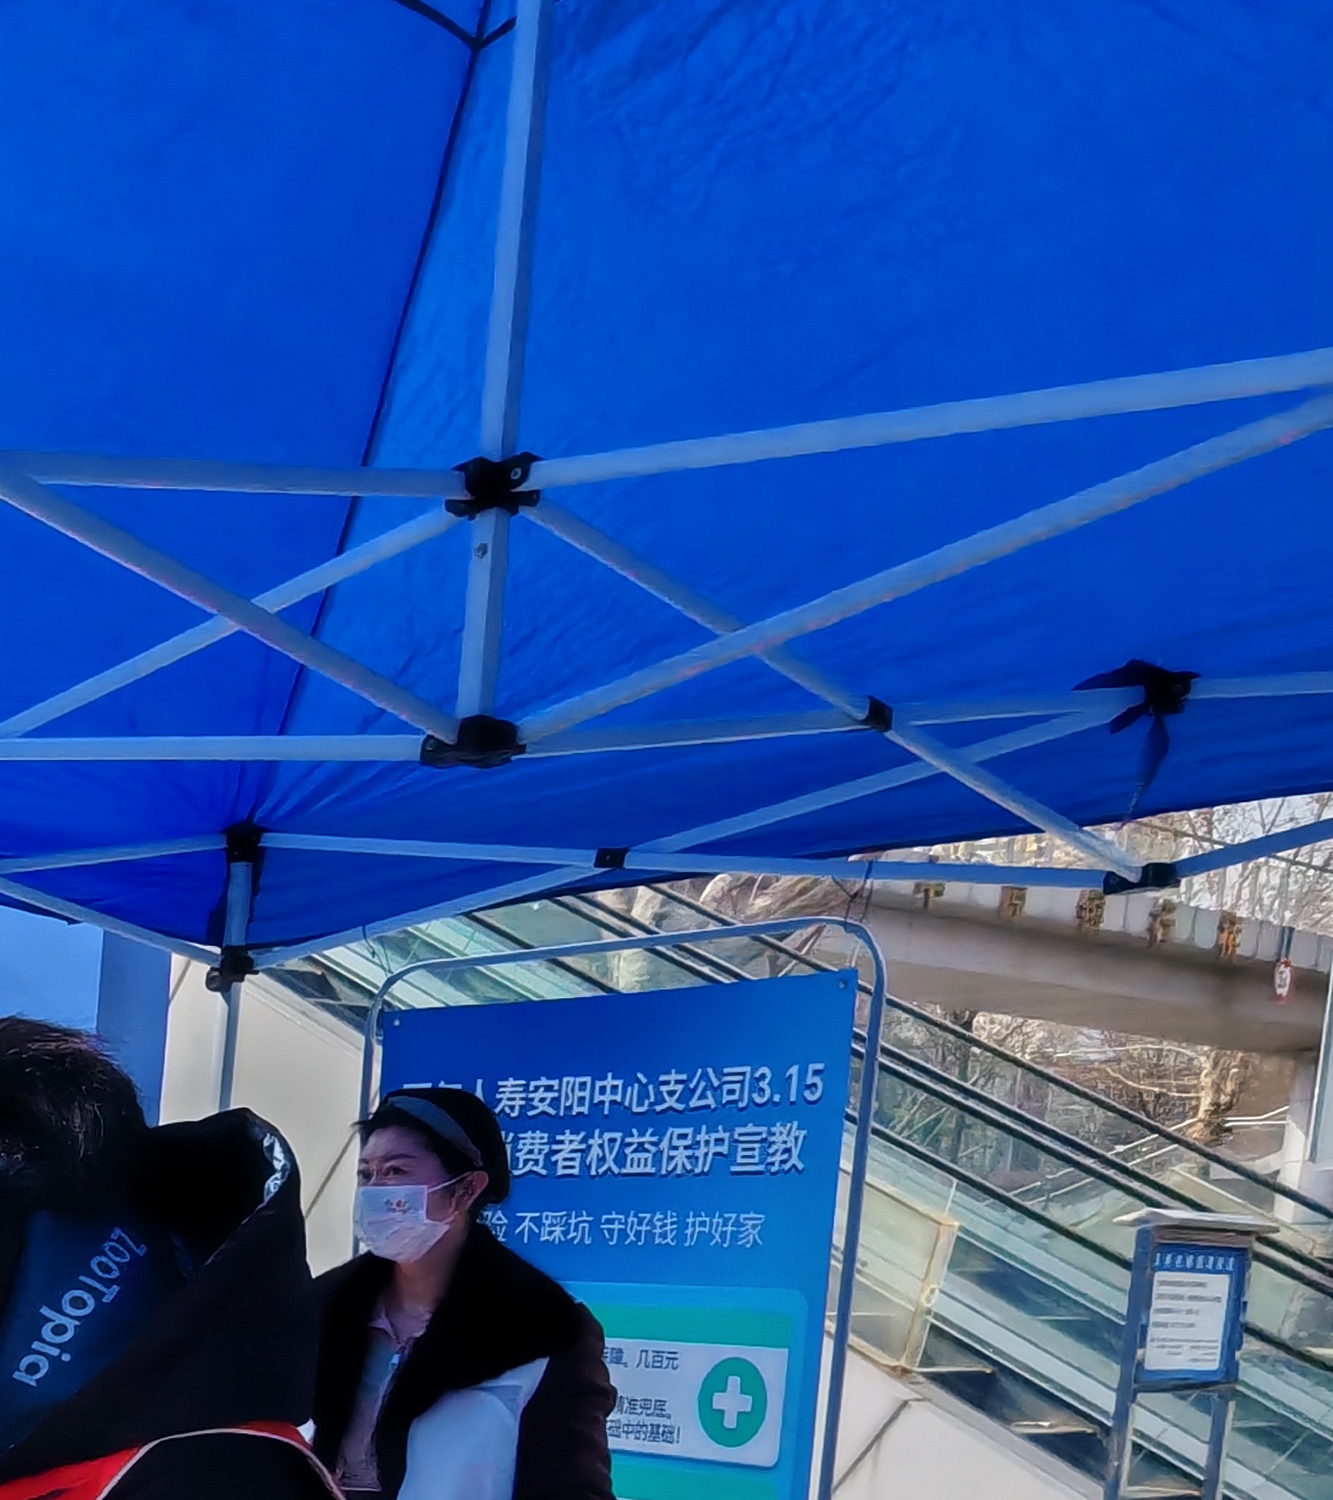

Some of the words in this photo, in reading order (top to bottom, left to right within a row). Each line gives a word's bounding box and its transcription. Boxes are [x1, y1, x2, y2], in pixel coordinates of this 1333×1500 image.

[500, 1121, 807, 1177] 费者权益保护宣教
[515, 1211, 593, 1246] 不踩坑
[600, 1211, 678, 1247] 守好钱
[684, 1211, 764, 1248] 护好家
